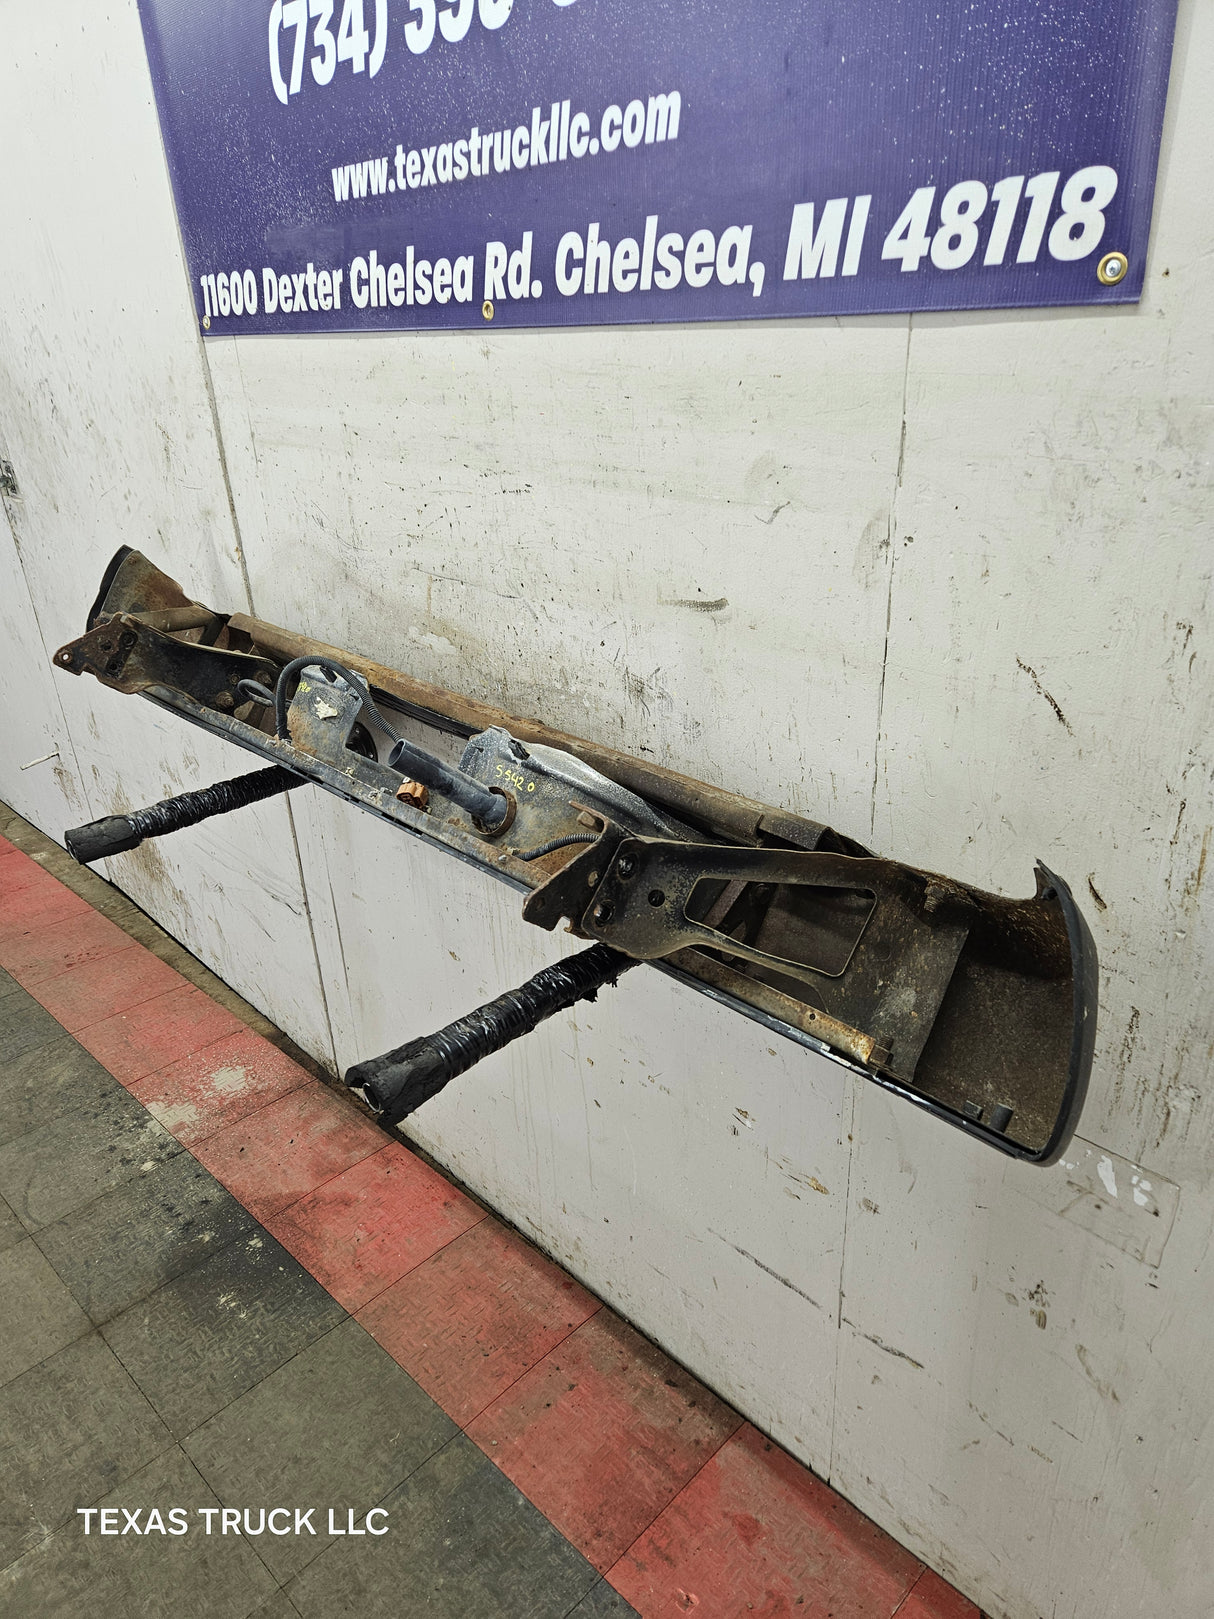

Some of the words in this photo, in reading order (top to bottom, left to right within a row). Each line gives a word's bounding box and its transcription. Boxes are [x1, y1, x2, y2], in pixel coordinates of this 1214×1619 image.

[268, 0, 388, 105] (734)
[331, 91, 682, 202] www.texastruckllc.com
[200, 269, 258, 318] 11600
[262, 262, 343, 314] Dexter
[349, 246, 474, 309] Chelsea
[484, 231, 543, 301] Rd.
[555, 215, 766, 298] Chelsea,
[783, 195, 872, 281] MI
[881, 166, 1119, 273] 48118
